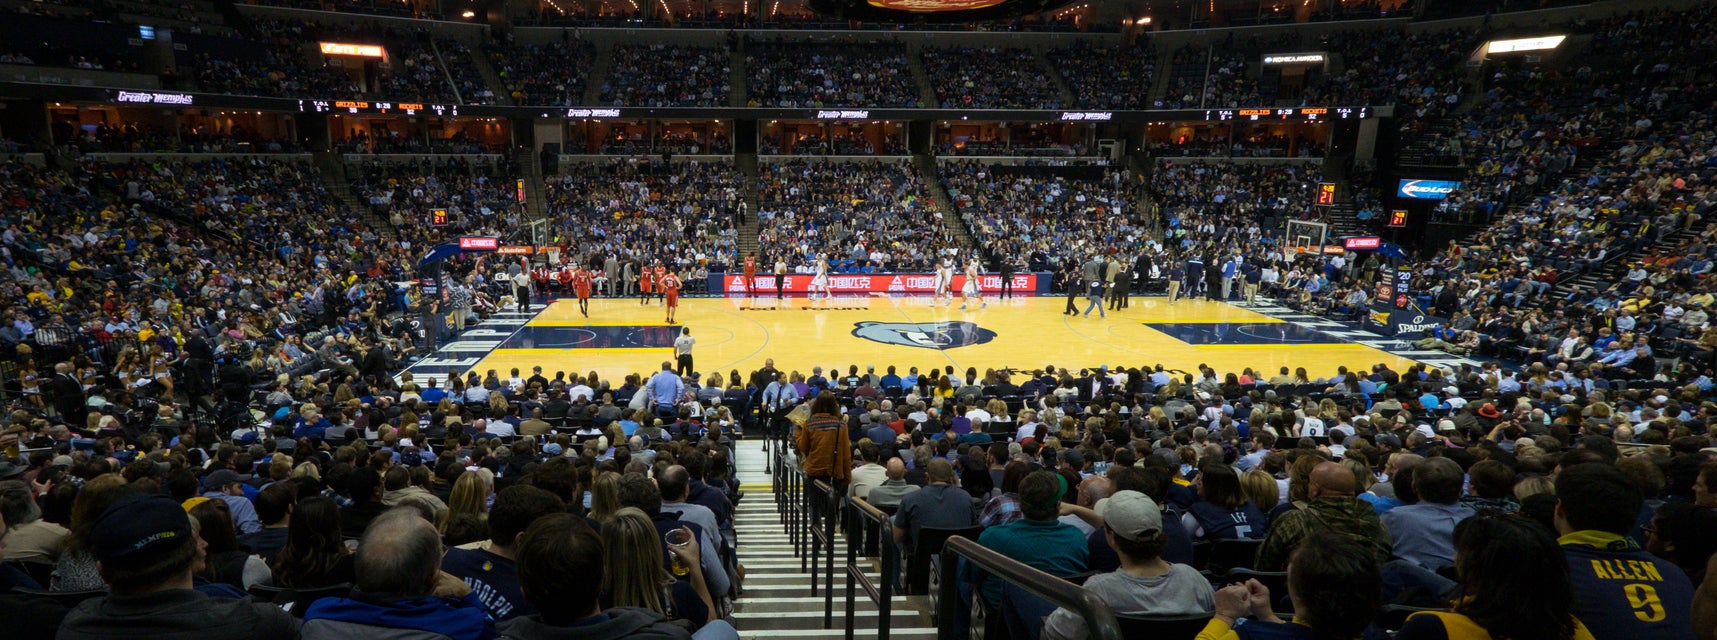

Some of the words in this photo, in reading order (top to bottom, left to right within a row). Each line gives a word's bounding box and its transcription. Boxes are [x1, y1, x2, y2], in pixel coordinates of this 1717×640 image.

[118, 91, 152, 103] Greater
[568, 109, 591, 117] Greater
[1320, 192, 1332, 204] 21
[828, 277, 871, 288] 中国匹克
[1230, 512, 1247, 523] LEE
[1590, 559, 1664, 581] ALLEN
[1623, 584, 1666, 622] 9
